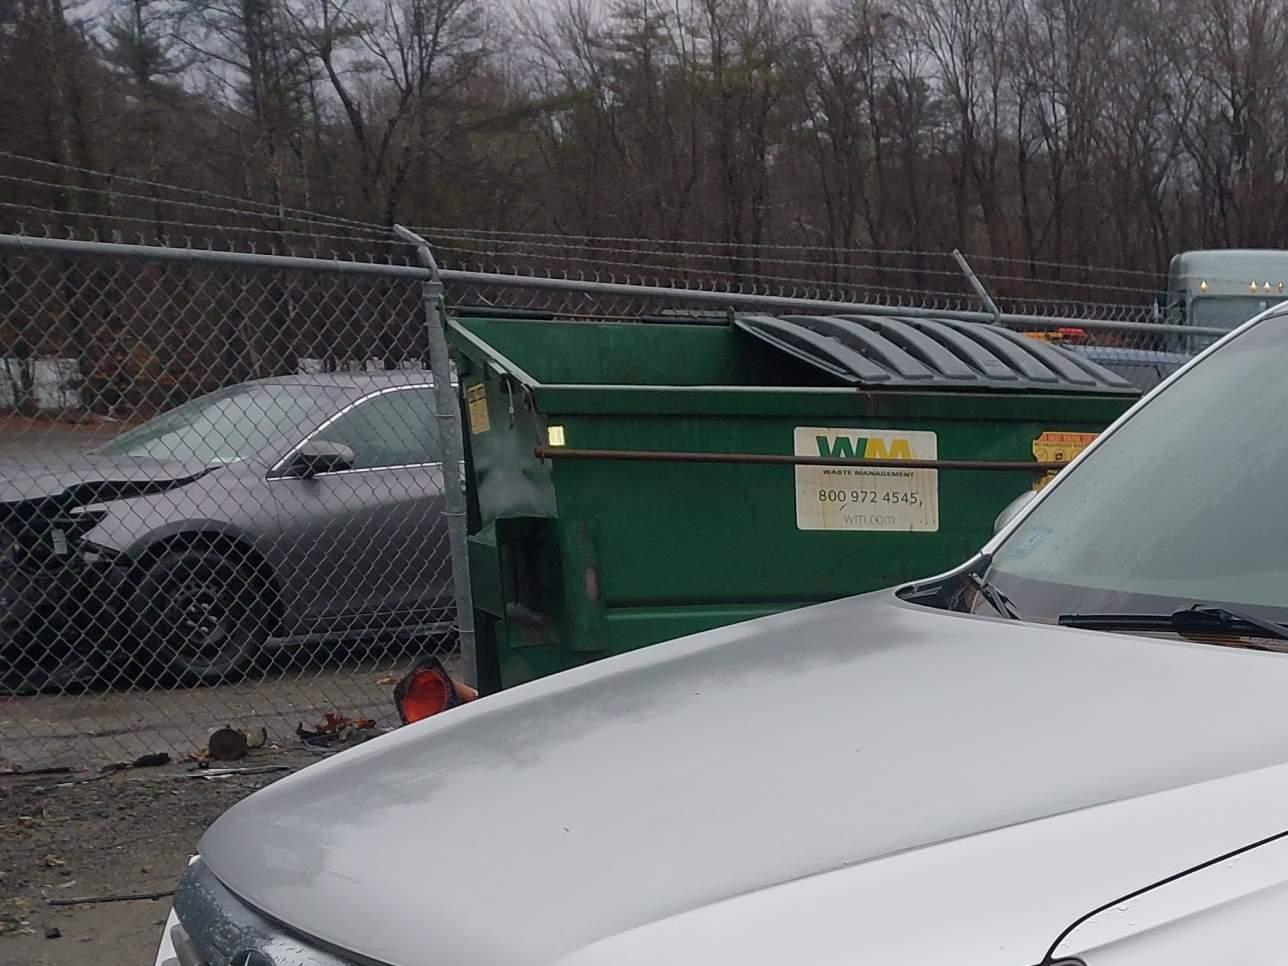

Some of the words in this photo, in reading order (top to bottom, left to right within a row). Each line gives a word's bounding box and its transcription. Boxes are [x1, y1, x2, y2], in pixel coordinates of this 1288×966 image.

[854, 470, 914, 478] MANAGEMENT
[818, 489, 846, 503] 800
[850, 490, 878, 504] 972
[882, 490, 917, 505] 4545
